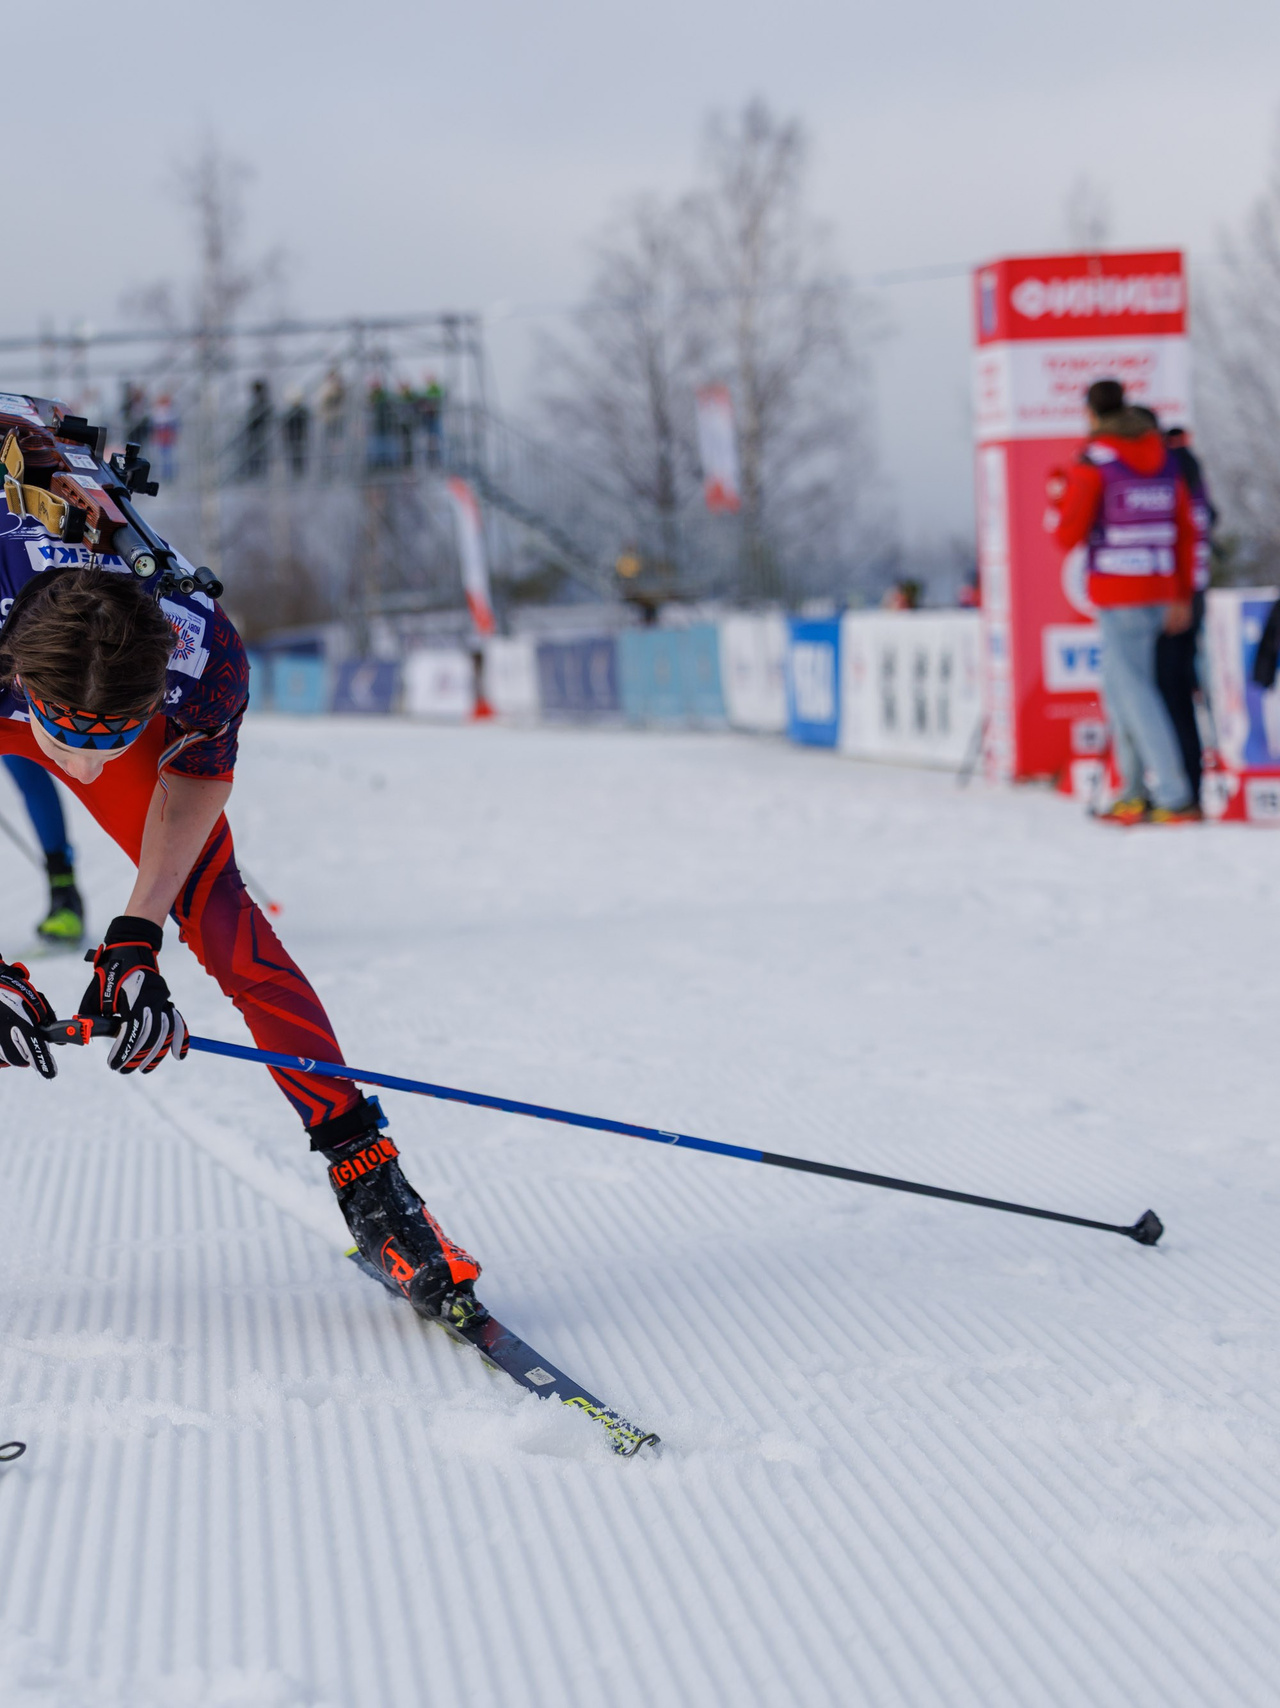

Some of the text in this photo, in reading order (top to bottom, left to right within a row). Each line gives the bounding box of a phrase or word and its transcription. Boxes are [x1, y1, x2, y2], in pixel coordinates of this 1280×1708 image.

[1012, 275, 1183, 318] ФИНИШ
[38, 544, 122, 566] VEKA
[1061, 647, 1102, 671] VE
[121, 1043, 132, 1062] SKI
